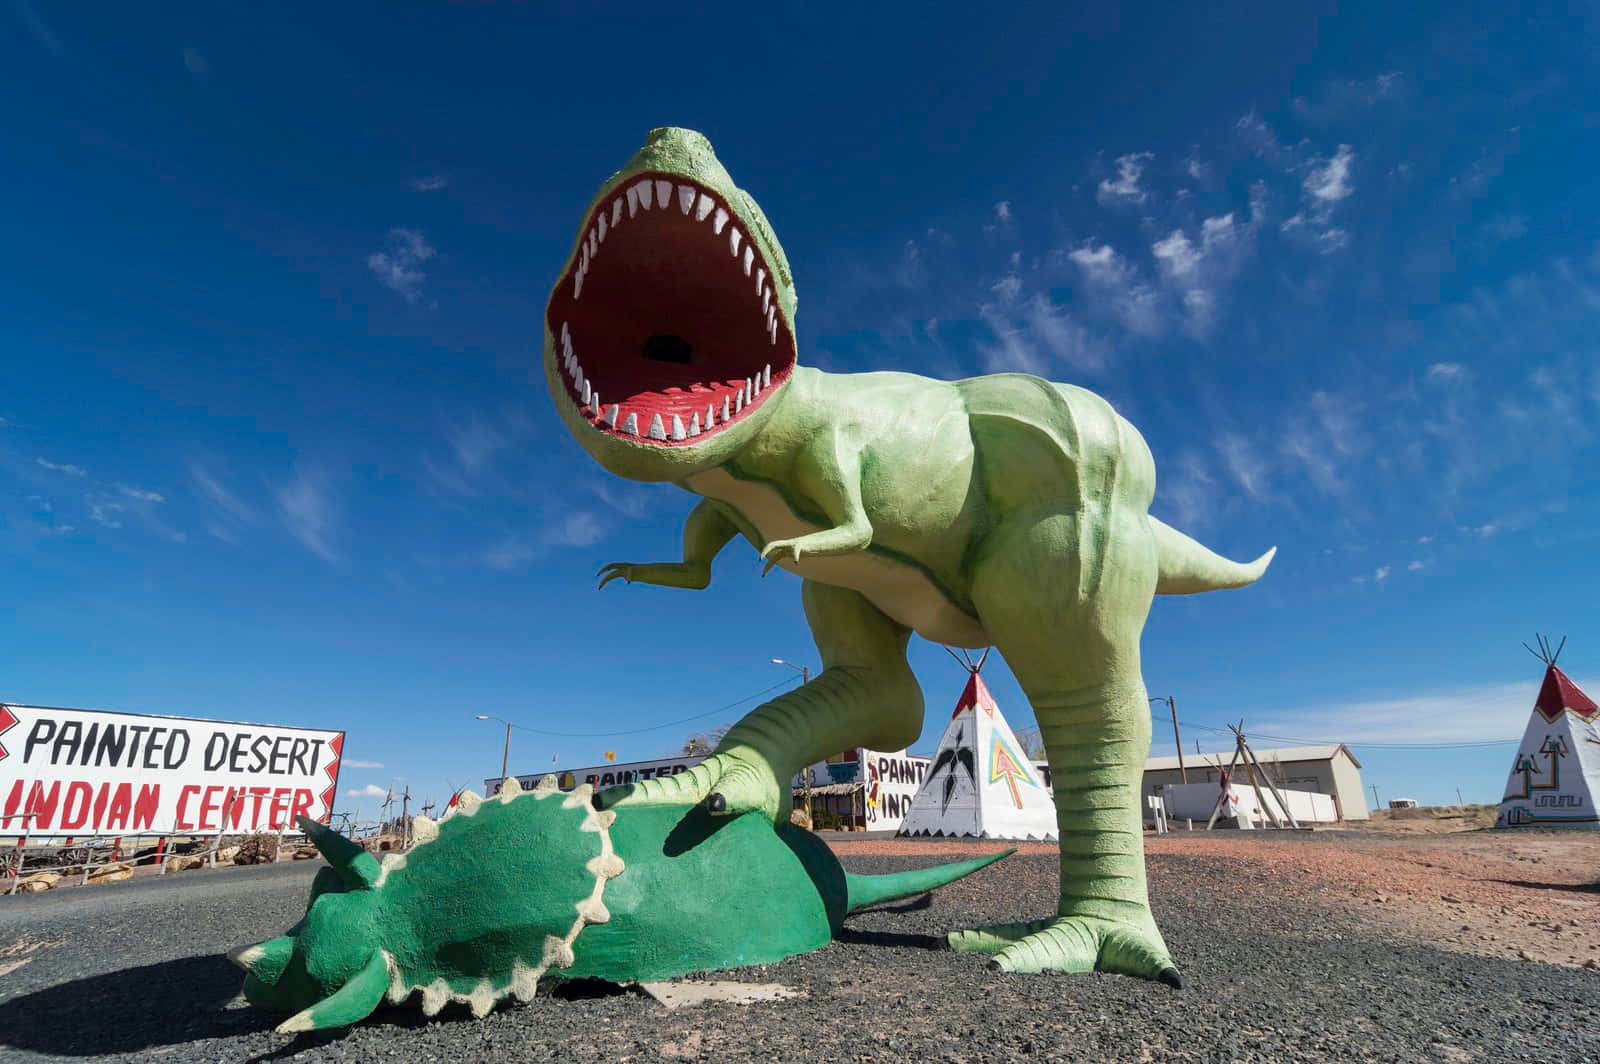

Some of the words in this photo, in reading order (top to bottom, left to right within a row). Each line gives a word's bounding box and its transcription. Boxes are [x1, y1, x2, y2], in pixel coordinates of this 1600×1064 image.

[24, 719, 190, 769] PAINTED
[204, 732, 325, 776] DESERT
[880, 757, 929, 784] PAINT
[1, 779, 160, 830] INDIAN
[176, 784, 314, 830] CENTER
